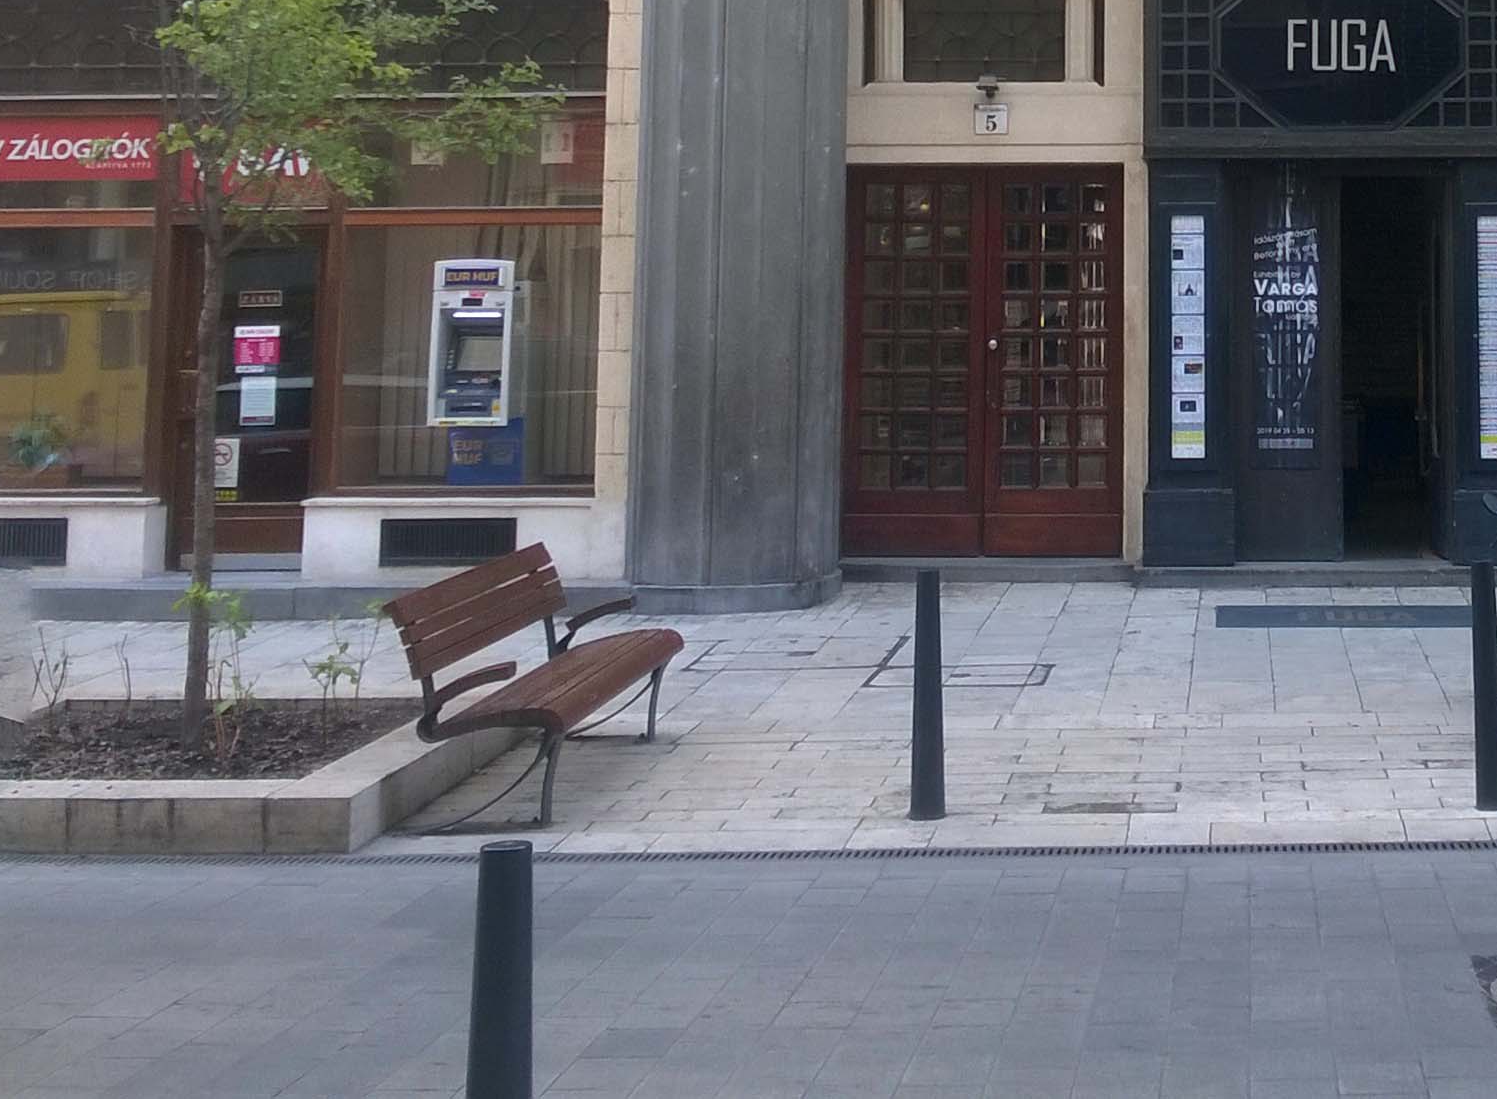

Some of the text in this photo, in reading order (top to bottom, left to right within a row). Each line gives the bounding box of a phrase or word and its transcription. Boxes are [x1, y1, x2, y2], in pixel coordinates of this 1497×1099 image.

[1287, 19, 1396, 72] FUGA
[986, 114, 997, 132] 5
[446, 271, 498, 281] EUR HUF
